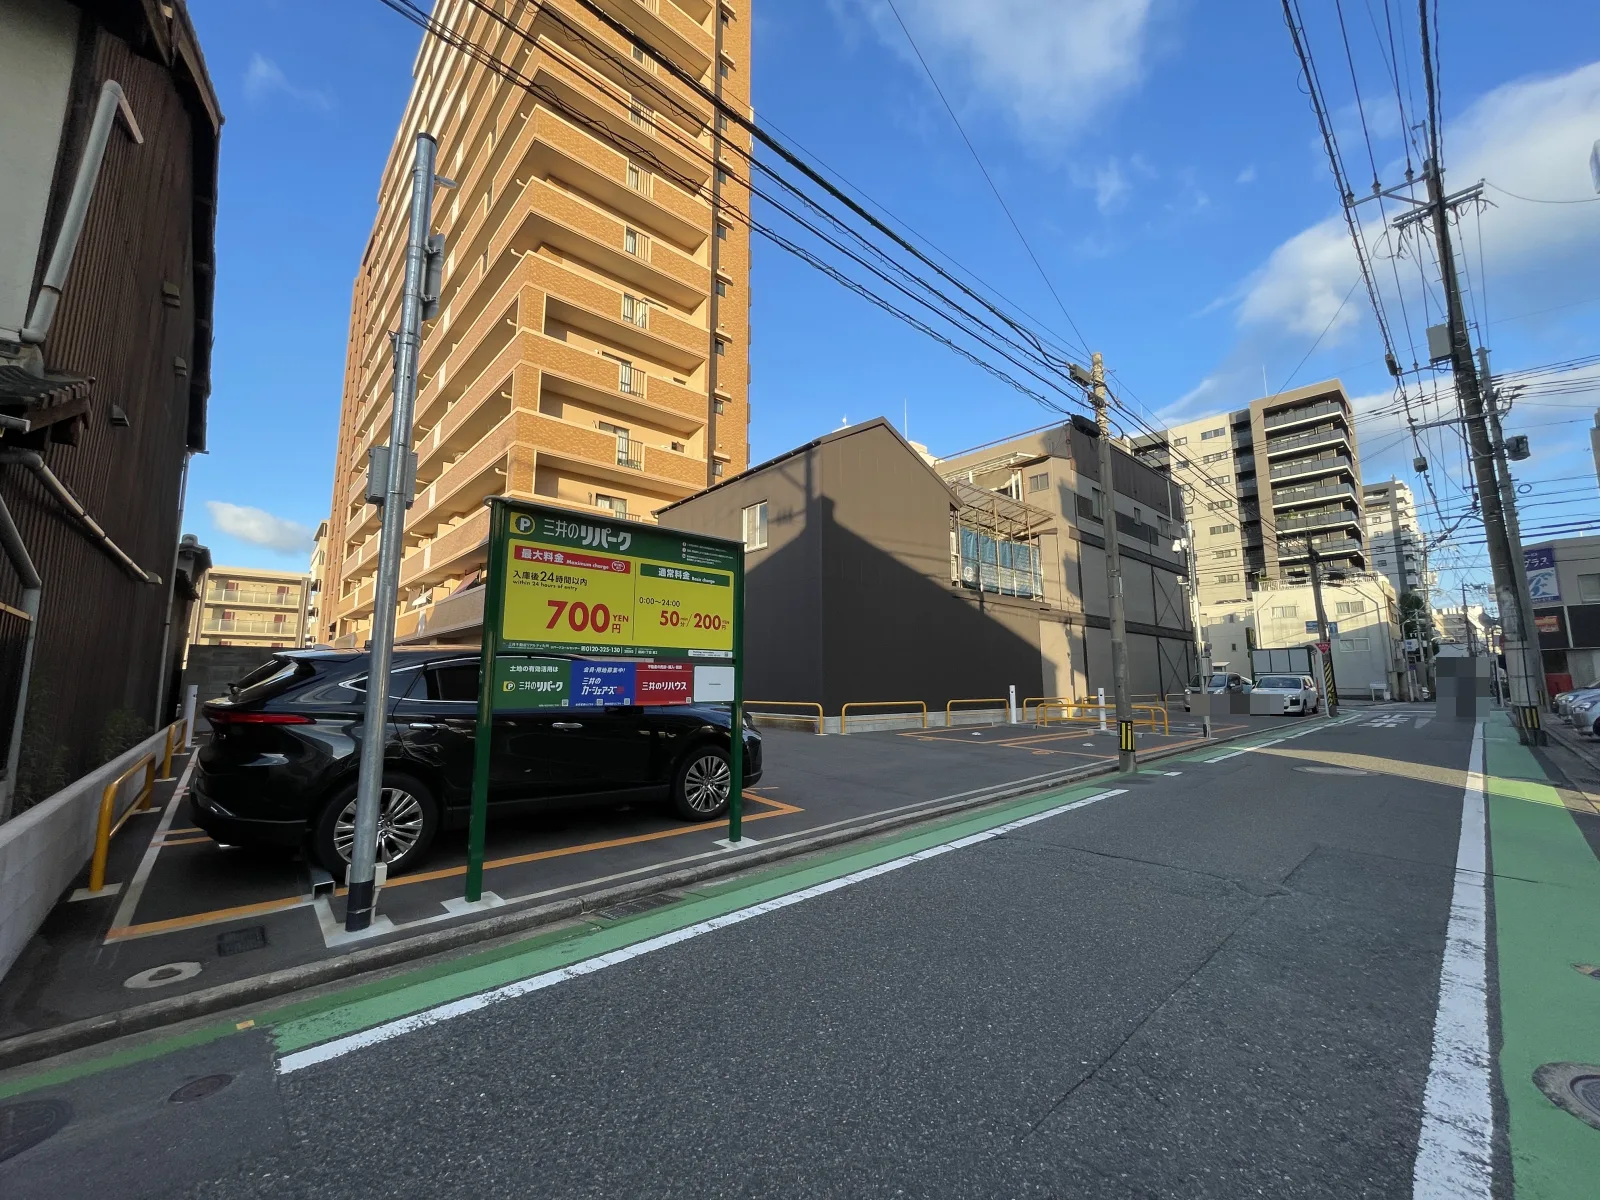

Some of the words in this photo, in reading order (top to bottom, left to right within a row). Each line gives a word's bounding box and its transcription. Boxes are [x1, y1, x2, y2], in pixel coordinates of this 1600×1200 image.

[543, 518, 631, 551] 三井のリパーク
[521, 548, 564, 563] 最大料金
[566, 559, 592, 567] Maximum
[592, 562, 609, 570] charge
[513, 570, 588, 586] 入庫後24時間以内
[658, 567, 690, 580] 通常料金
[545, 600, 610, 633] 700
[612, 614, 629, 622] YEN
[659, 610, 680, 626] 50
[693, 612, 721, 630] 200
[612, 624, 621, 633] 円
[509, 665, 559, 673] 土地の有効活用は
[519, 680, 563, 692] 三井のリパーク
[582, 677, 601, 685] 三井の
[642, 681, 687, 691] 三井のリハウス
